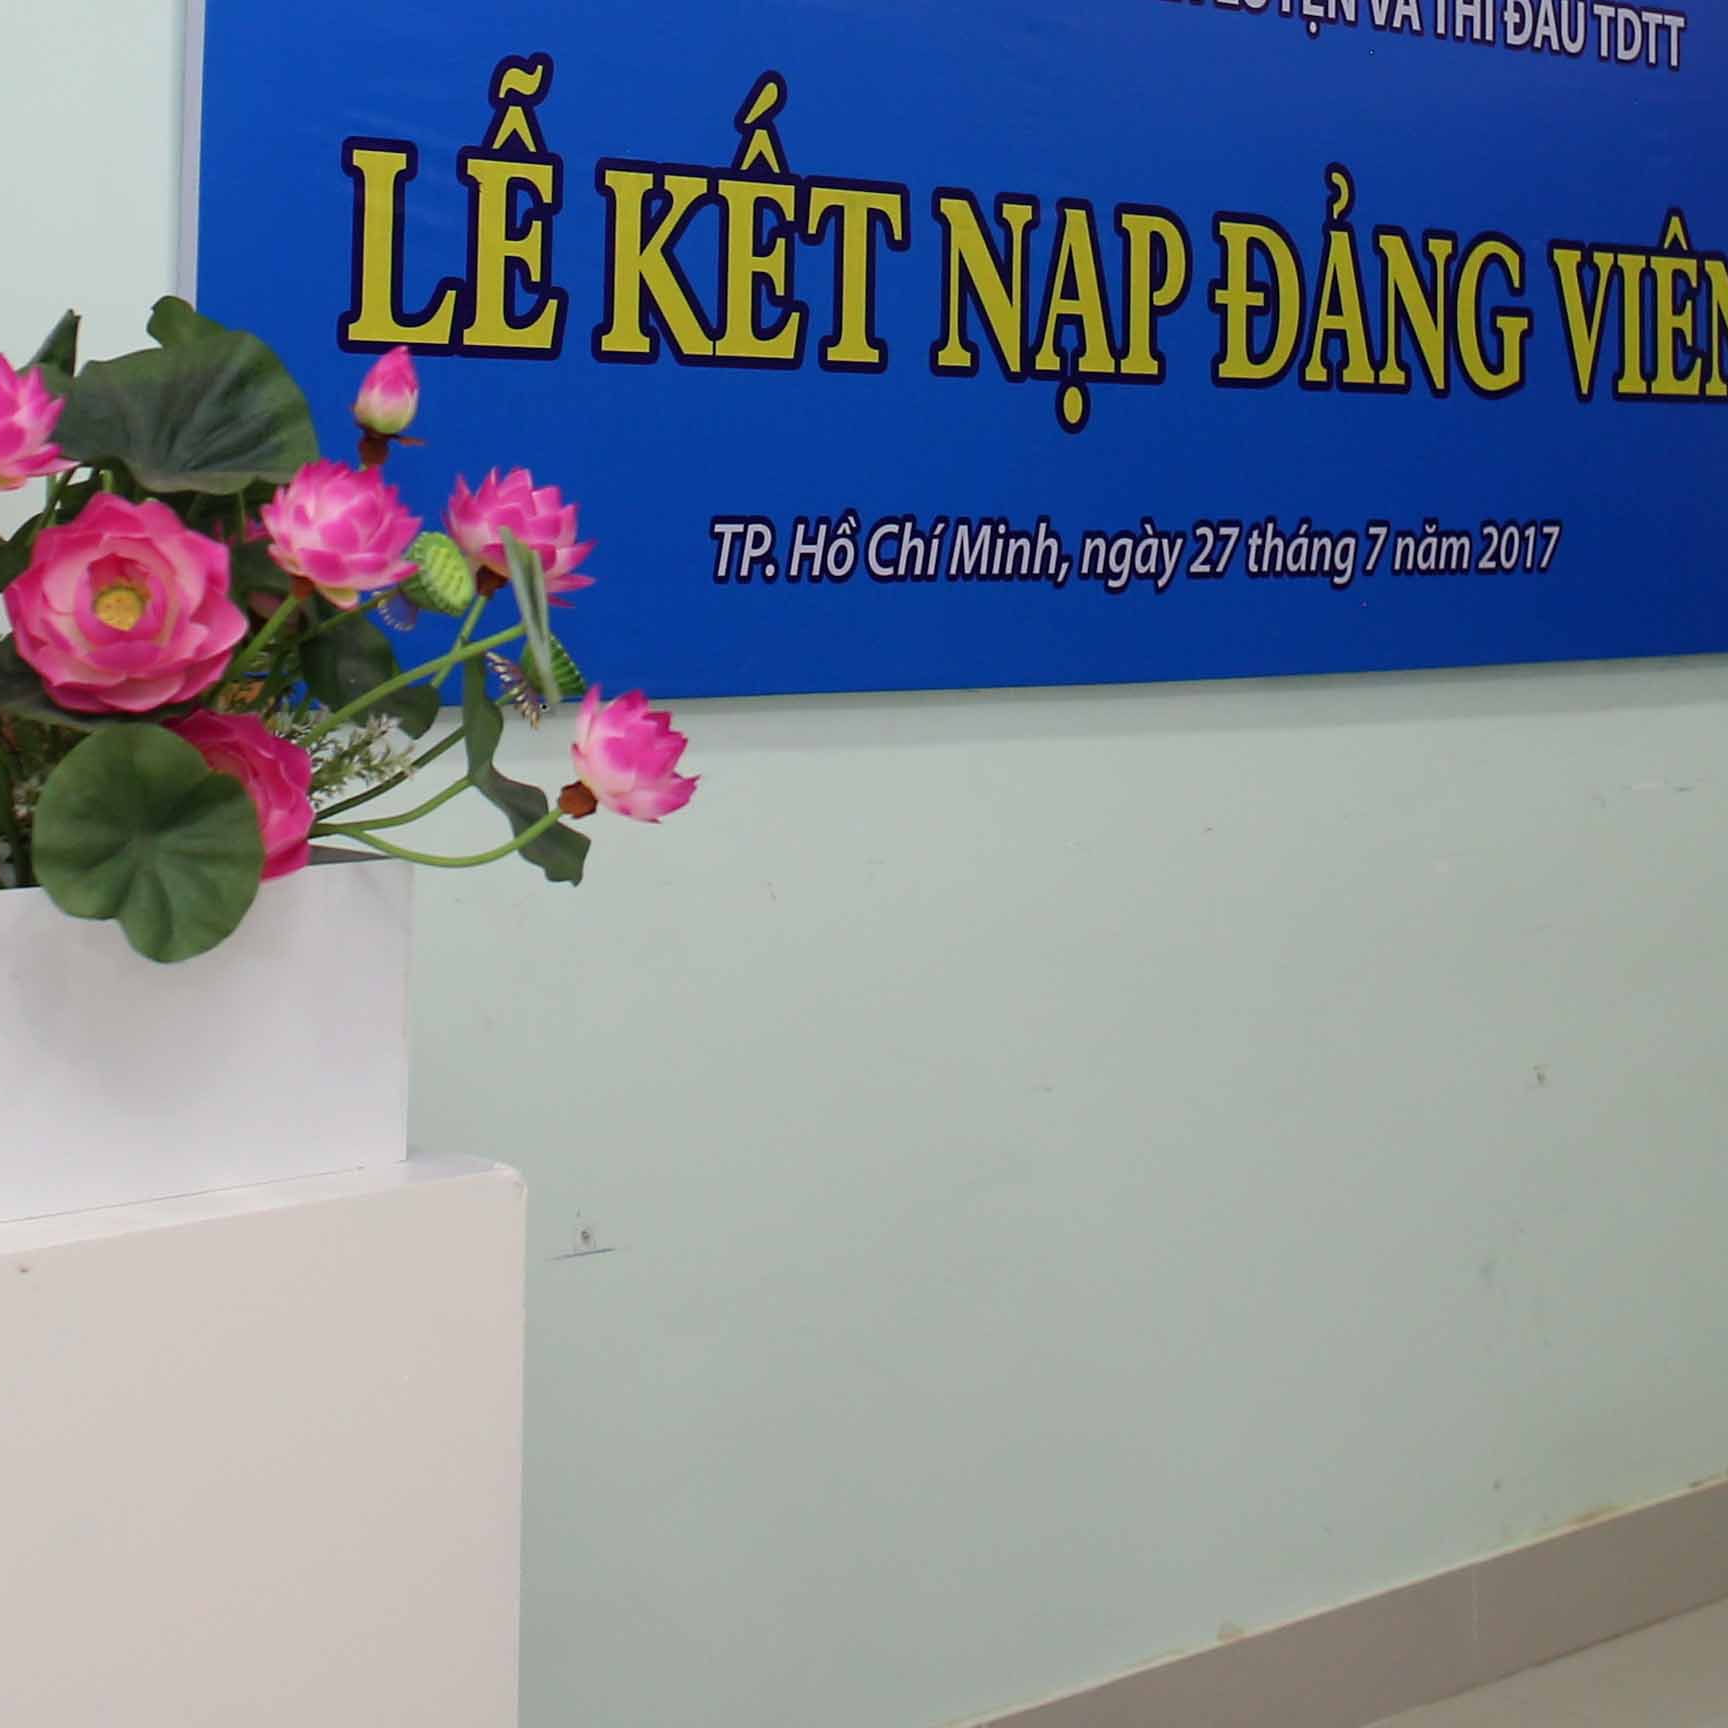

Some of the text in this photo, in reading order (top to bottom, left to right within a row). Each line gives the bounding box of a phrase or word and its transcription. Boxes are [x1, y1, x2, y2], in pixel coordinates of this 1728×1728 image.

[1593, 2, 1687, 69] TDTT
[348, 69, 559, 349] LỄ
[602, 84, 904, 364] KẾT
[936, 199, 1187, 423] NẠP
[1215, 172, 1530, 393] ĐẢNG
[712, 515, 1562, 590] TP. Hồ Chí Minh, ngày 27 tháng 7 năm 2017
